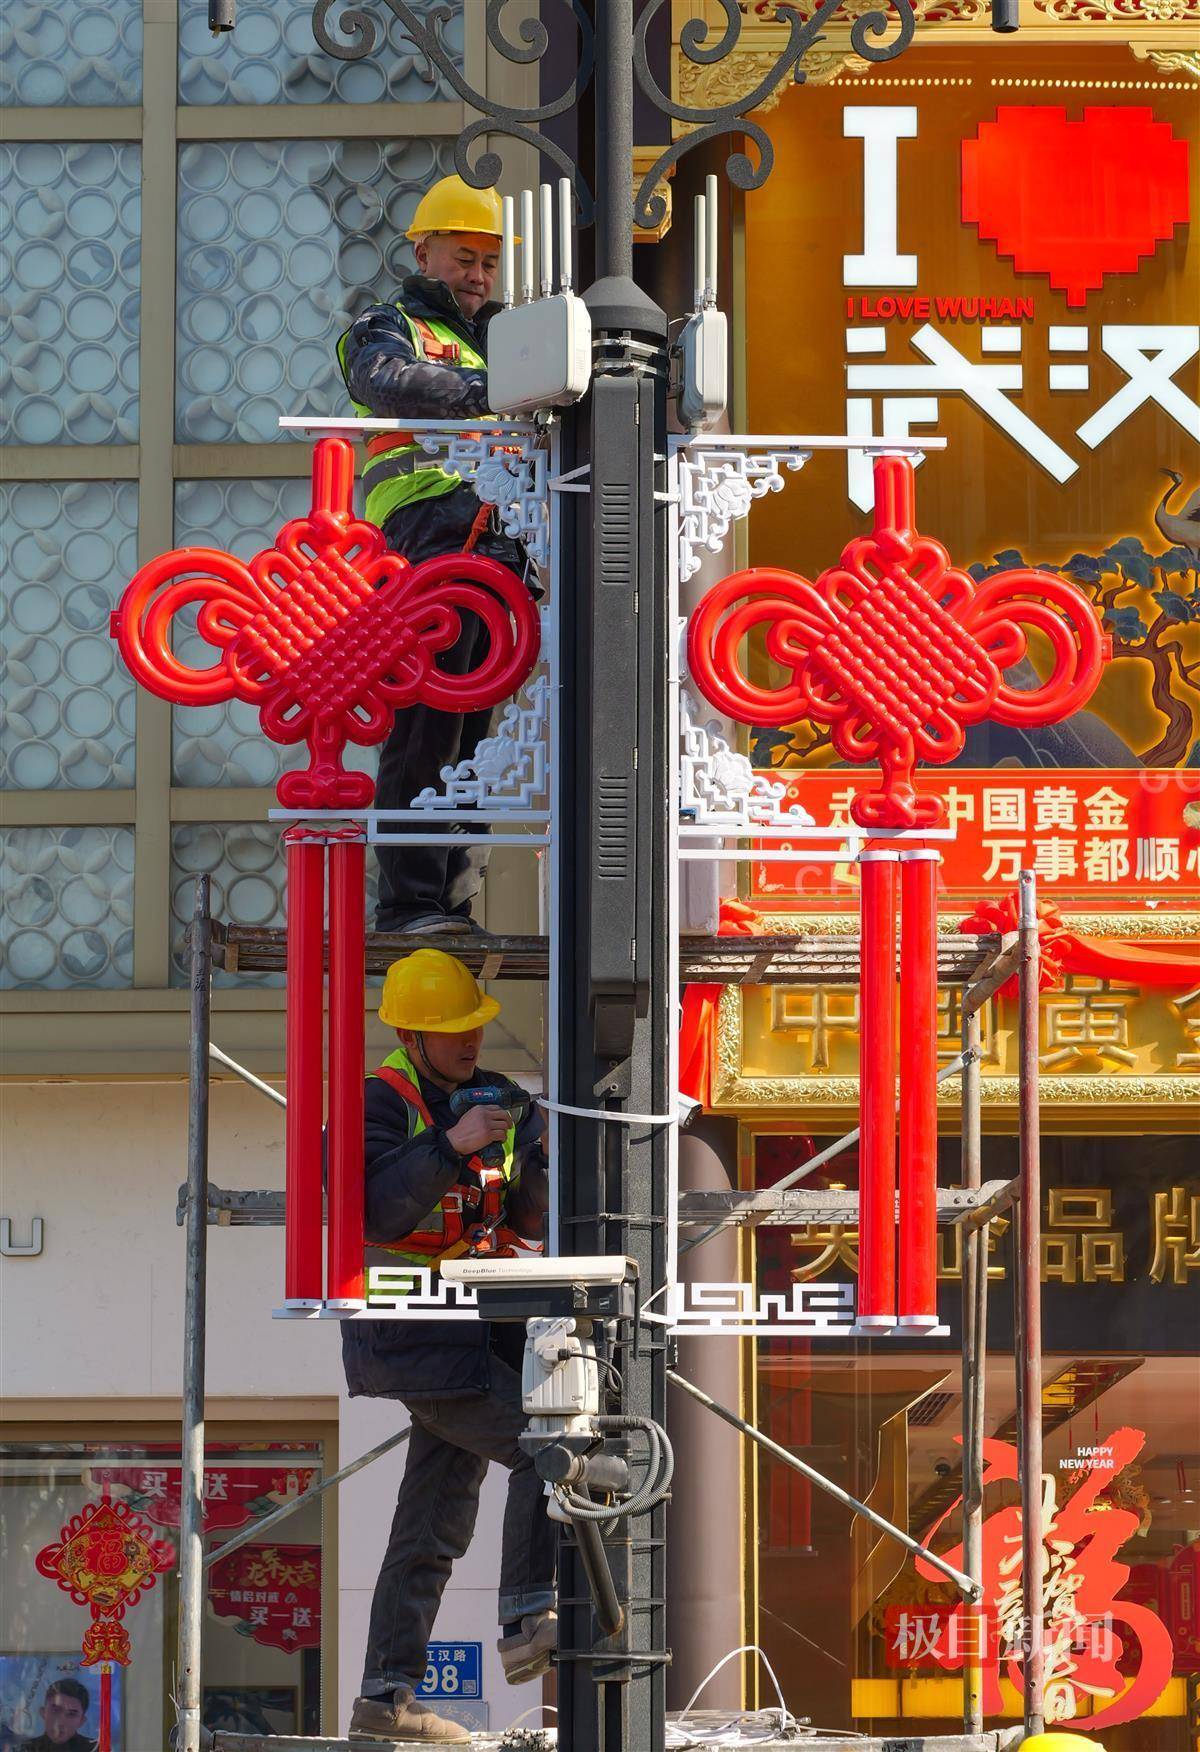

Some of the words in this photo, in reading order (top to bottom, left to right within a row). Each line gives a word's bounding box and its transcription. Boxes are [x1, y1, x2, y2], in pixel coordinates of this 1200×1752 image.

[844, 106, 917, 286] I
[847, 298, 854, 318] I
[861, 297, 930, 318] LOVE
[936, 297, 1034, 318] WUHAN
[828, 786, 1130, 832] 走中国黄金
[1077, 1446, 1114, 1456] HAPPY
[1059, 1459, 1085, 1469] NEW
[1085, 1459, 1114, 1469] YEAR
